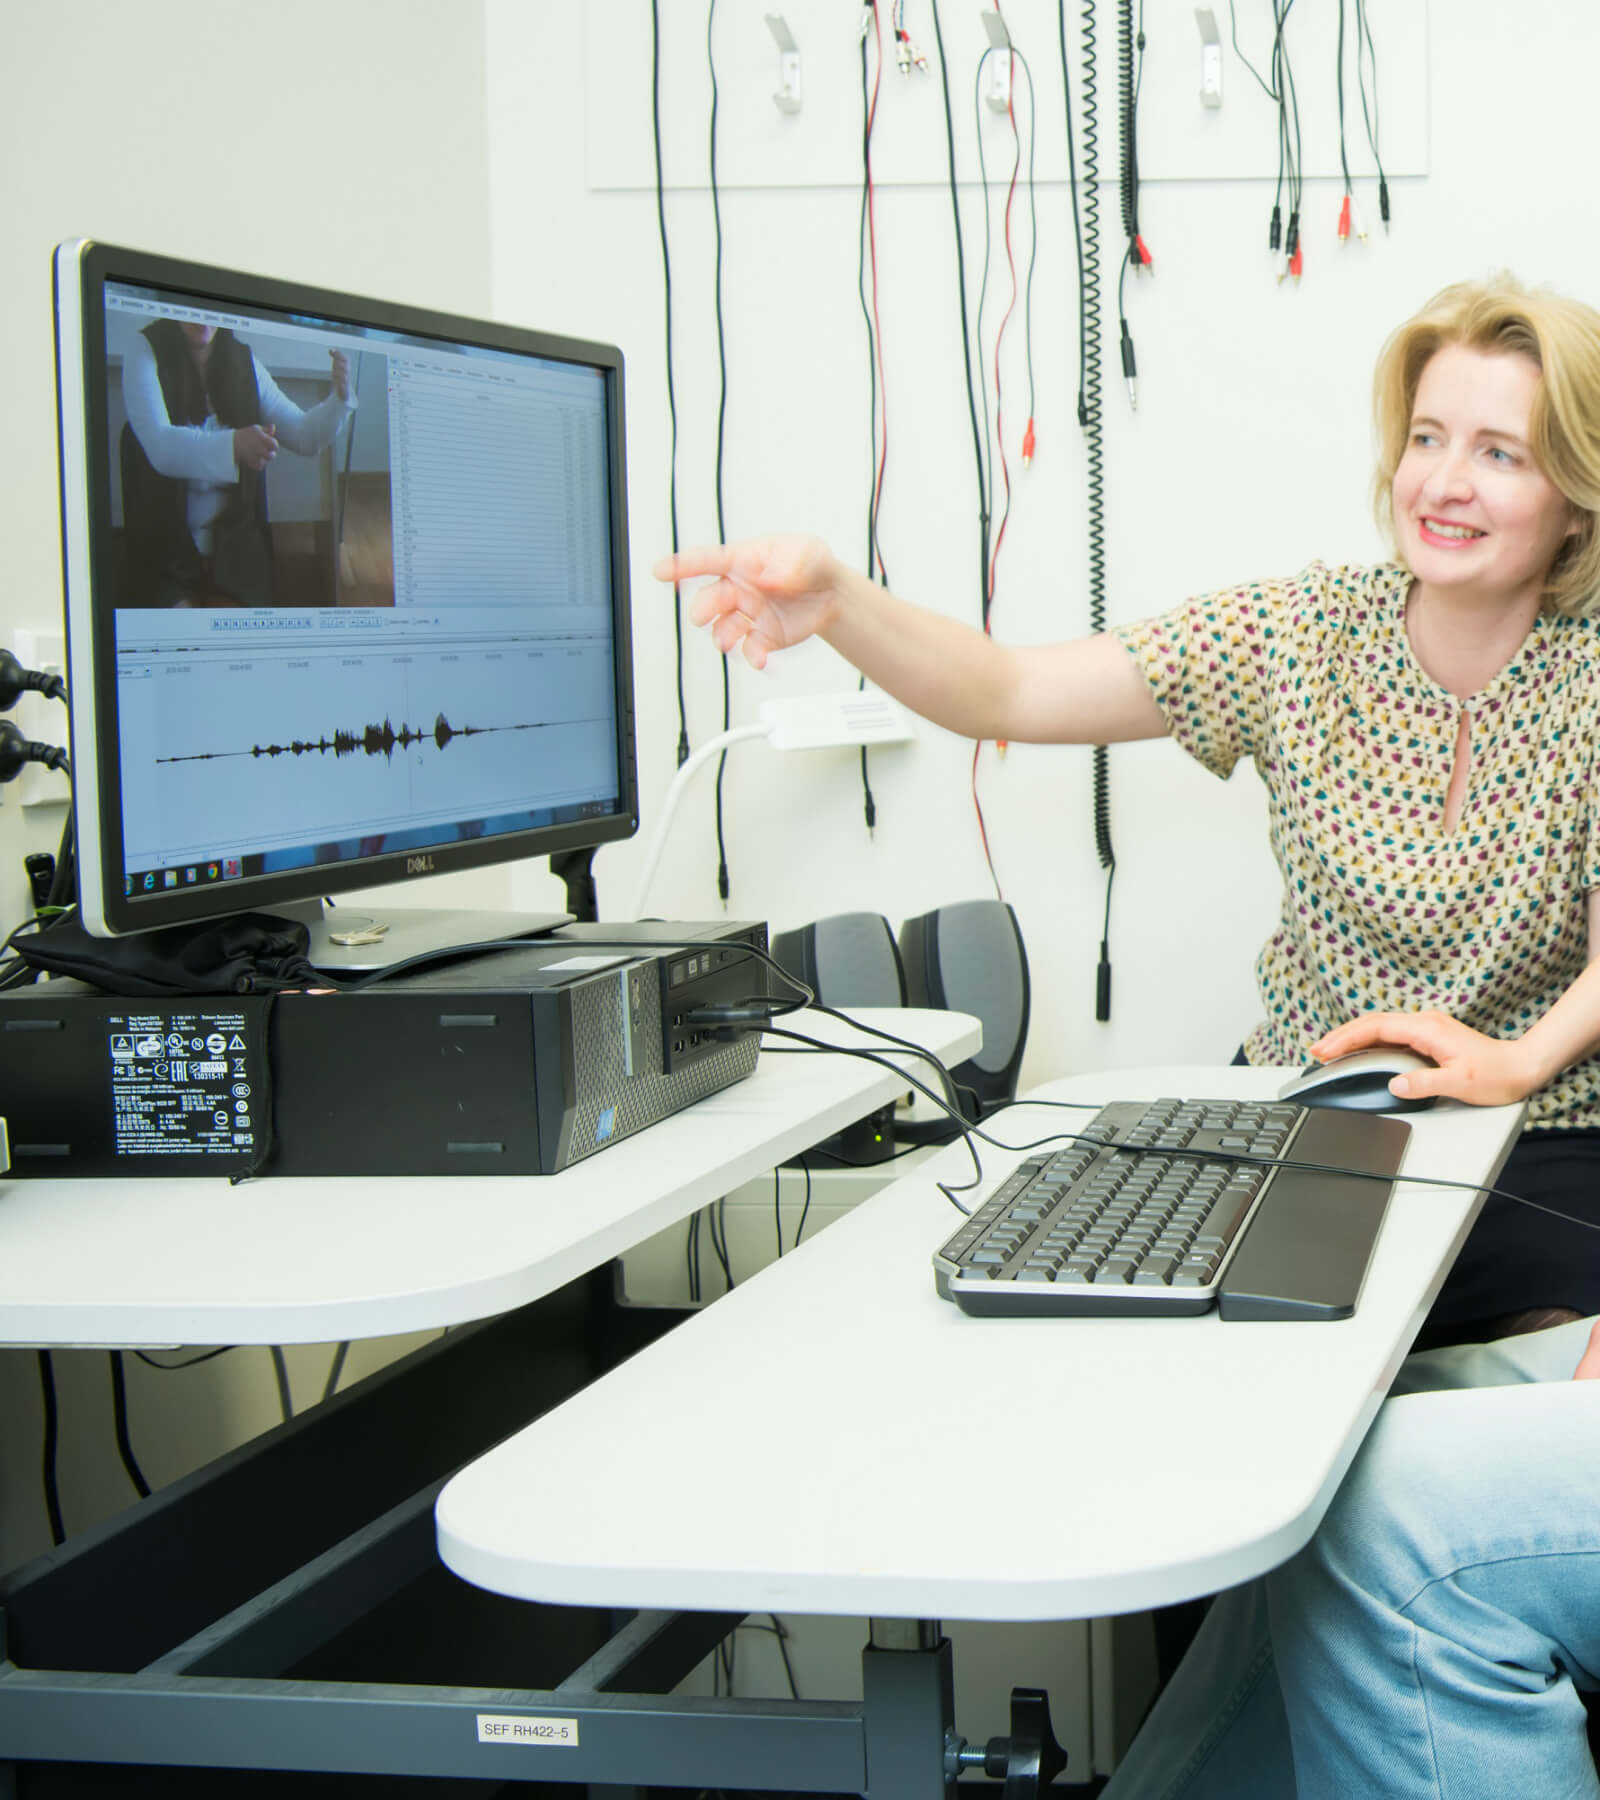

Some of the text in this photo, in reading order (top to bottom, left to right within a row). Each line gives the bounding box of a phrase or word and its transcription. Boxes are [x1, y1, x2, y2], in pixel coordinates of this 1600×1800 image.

[407, 855, 435, 873] DELL
[484, 1724, 569, 1738] SEF RH422-5
